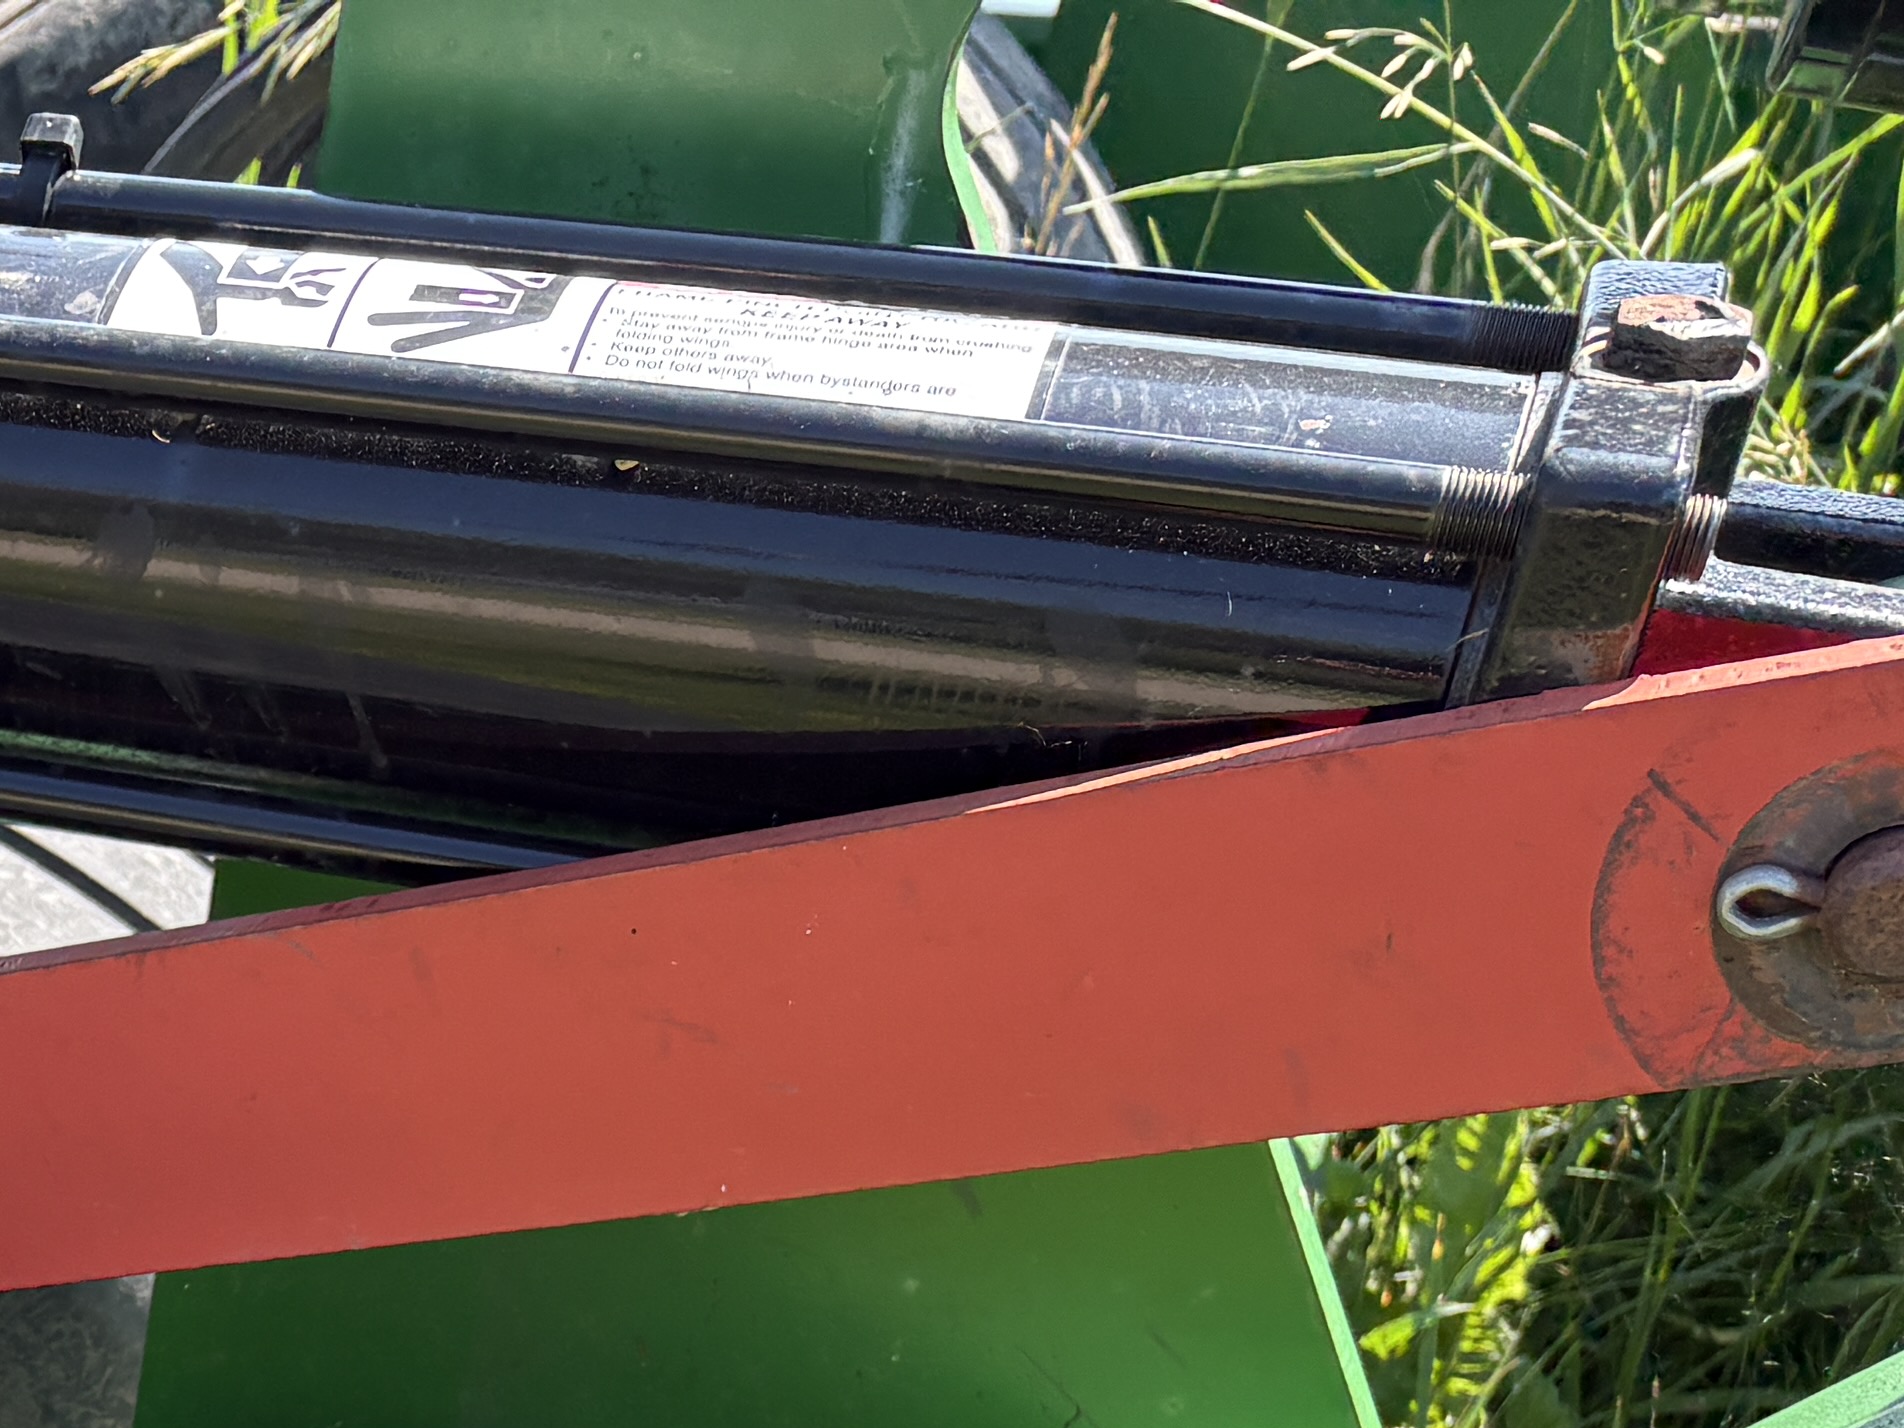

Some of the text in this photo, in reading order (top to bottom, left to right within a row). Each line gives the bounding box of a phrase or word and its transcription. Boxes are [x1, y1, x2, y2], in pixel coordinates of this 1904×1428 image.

[615, 327, 674, 345] folding
[666, 323, 713, 336] away
[718, 326, 759, 339] from
[765, 331, 816, 343] frame
[822, 335, 871, 350] hinge
[877, 341, 919, 353] area
[925, 345, 974, 358] when
[610, 341, 657, 356] Keep
[662, 344, 718, 361] others
[605, 353, 958, 397] Do not fold wings when bystanders are
